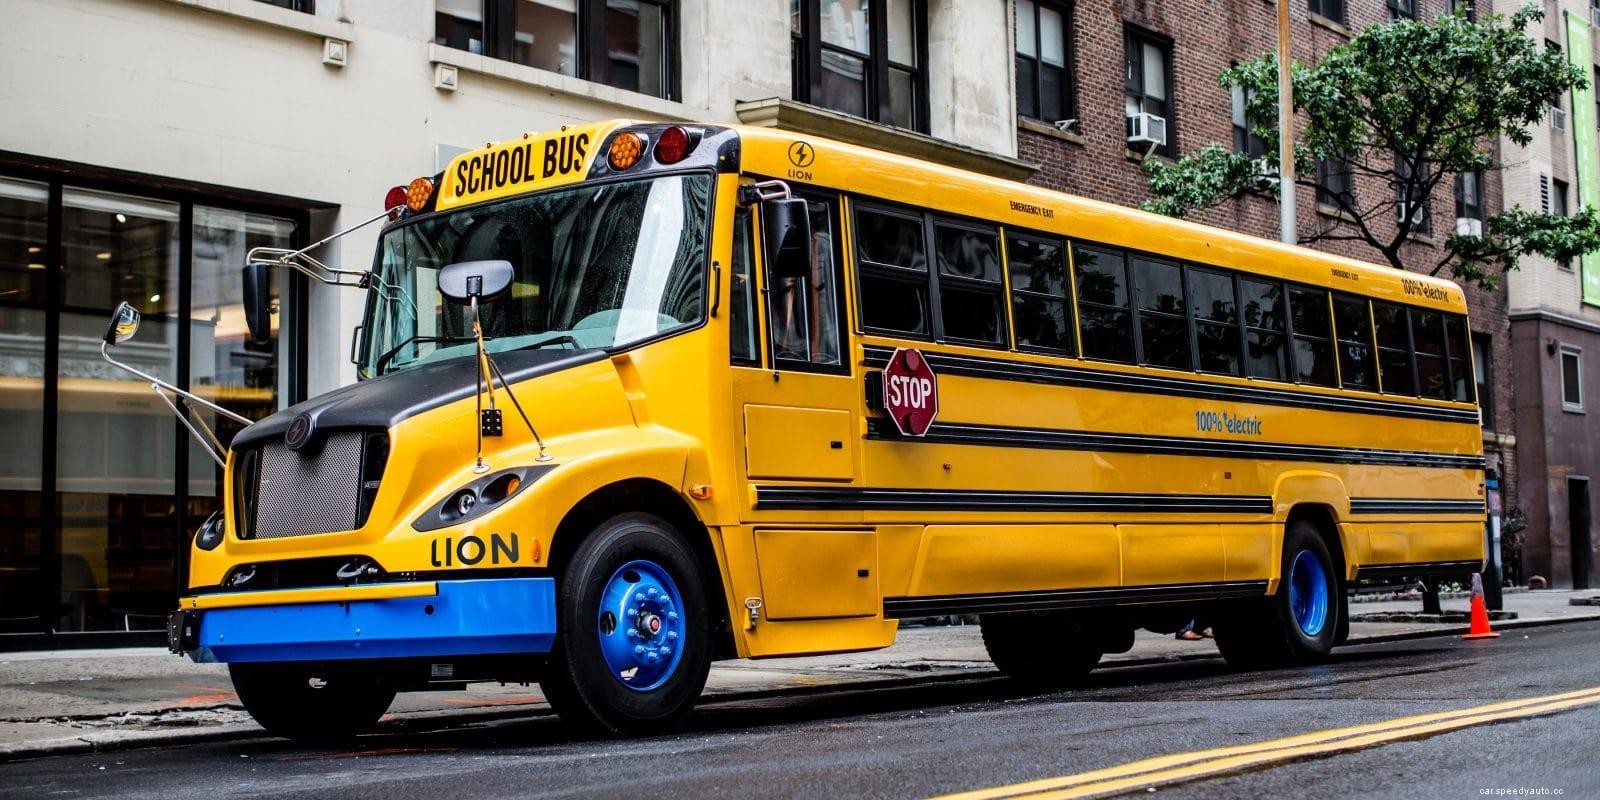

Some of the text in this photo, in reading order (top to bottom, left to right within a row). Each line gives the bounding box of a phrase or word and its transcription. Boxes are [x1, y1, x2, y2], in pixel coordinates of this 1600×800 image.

[455, 133, 589, 197] SCHOOL BUS
[788, 169, 812, 180] LION
[1010, 201, 1054, 218] EMERGENCY EXIT
[1401, 279, 1449, 302] 100% electric
[890, 375, 931, 408] STOP
[1195, 411, 1262, 435] 100% electric
[431, 532, 519, 567] LION
